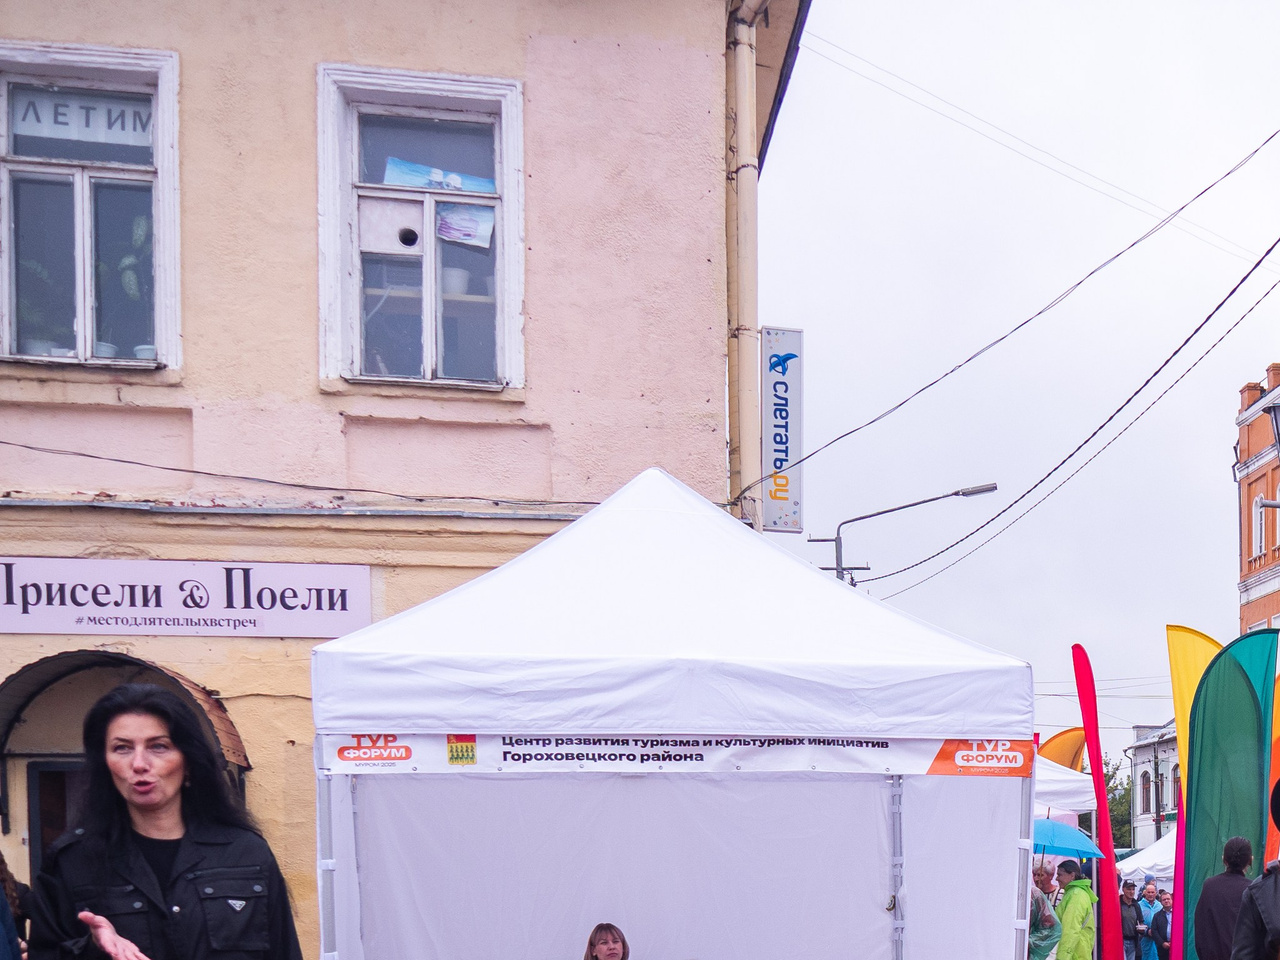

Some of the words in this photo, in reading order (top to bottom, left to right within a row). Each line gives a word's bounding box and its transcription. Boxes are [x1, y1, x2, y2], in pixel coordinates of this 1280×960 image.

[179, 579, 210, 609] &
[222, 567, 349, 612] Поели
[75, 615, 257, 629] #местодлятеплыхвстреч
[351, 733, 398, 747] ТУР
[501, 736, 552, 747] Центр
[555, 737, 630, 747] развития
[632, 738, 700, 748] туризма
[702, 738, 713, 747] и
[715, 737, 805, 748] культурных
[807, 738, 890, 749] инициатив
[343, 748, 406, 759] ФОРУМ
[502, 751, 637, 763] Гороховецкого
[640, 750, 705, 763] района
[961, 753, 1018, 764] ФОРУМ
